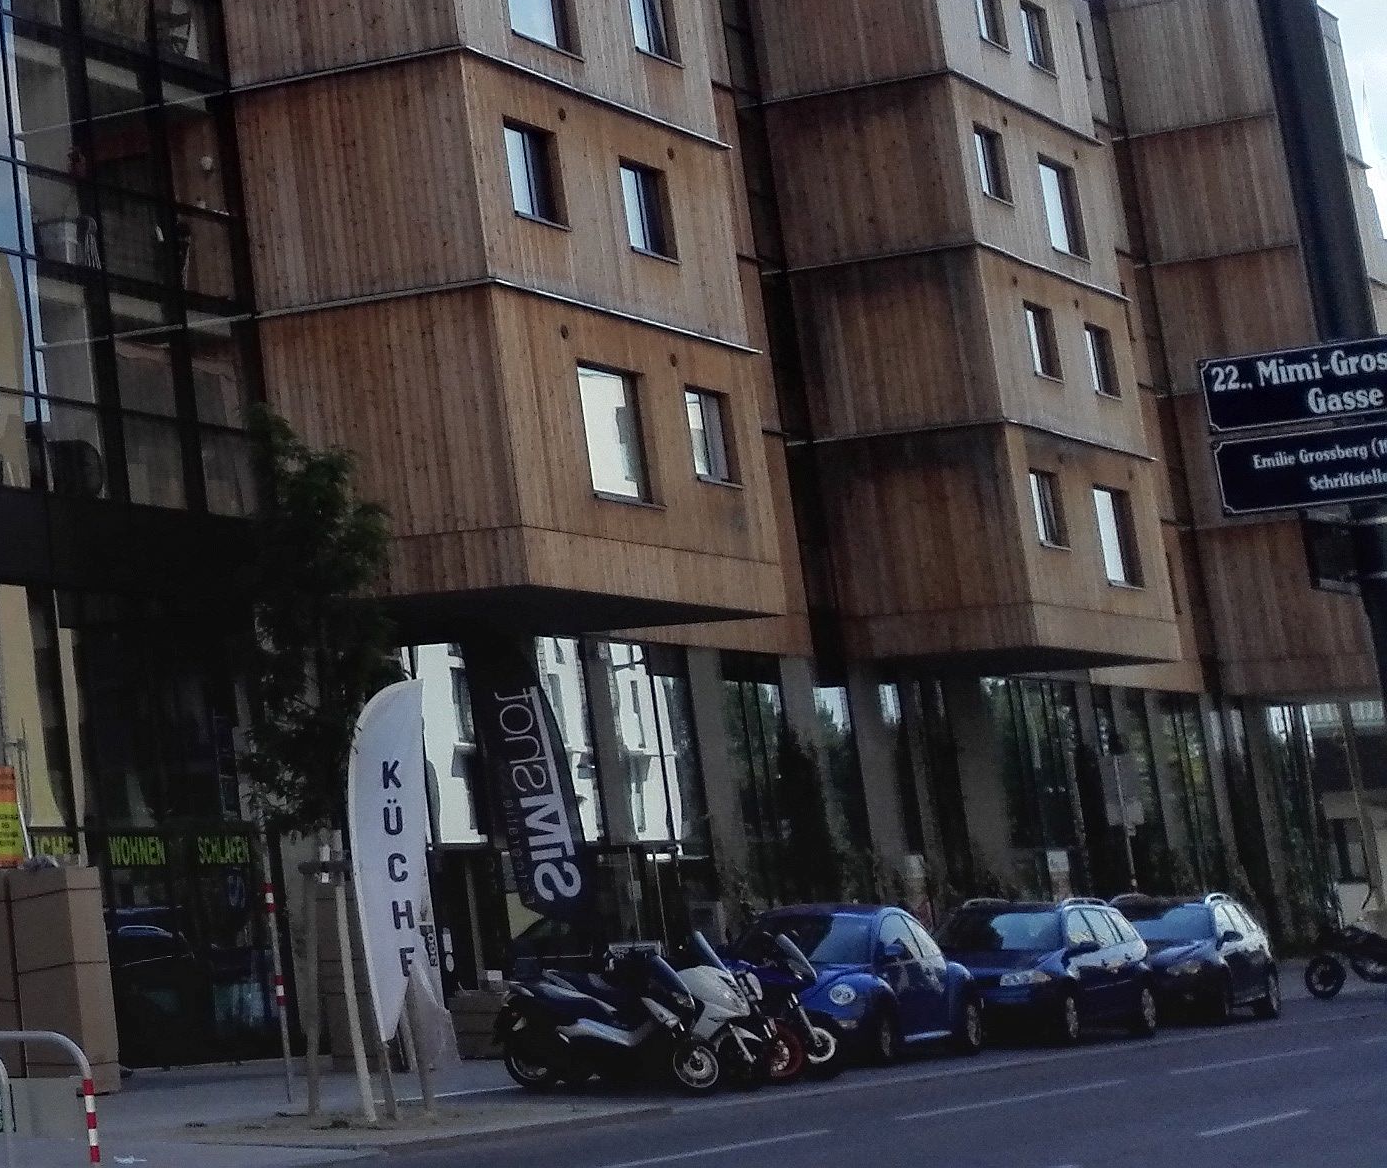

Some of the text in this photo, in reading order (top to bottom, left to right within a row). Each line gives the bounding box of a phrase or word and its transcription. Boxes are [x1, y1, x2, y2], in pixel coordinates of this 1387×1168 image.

[1308, 387, 1384, 414] Gasse
[1252, 450, 1296, 469] Emilie
[1299, 444, 1368, 464] Grossberg
[108, 836, 166, 865] WOHNEN
[197, 835, 250, 864] SCHLAFEN
